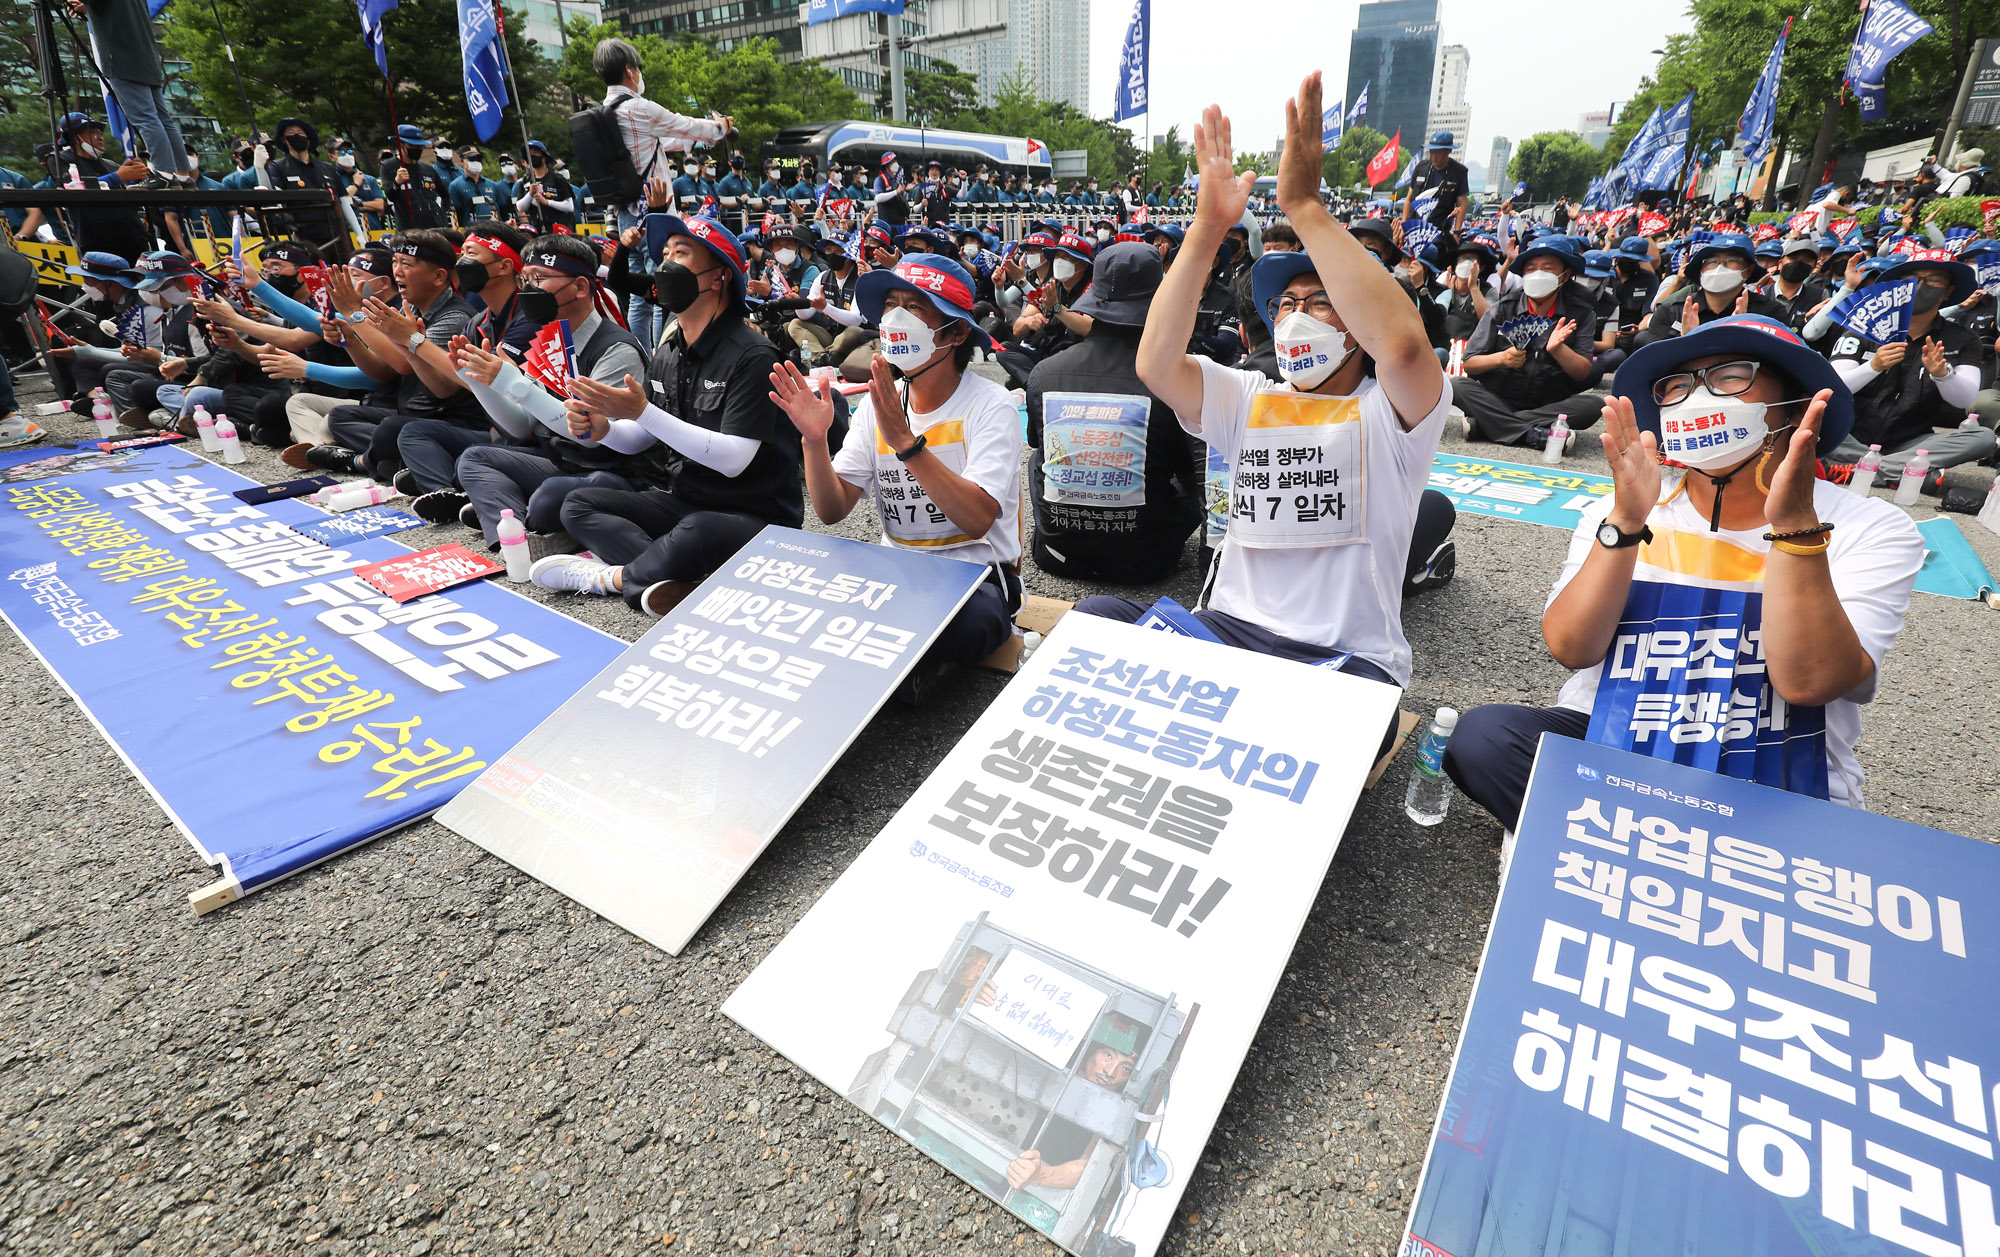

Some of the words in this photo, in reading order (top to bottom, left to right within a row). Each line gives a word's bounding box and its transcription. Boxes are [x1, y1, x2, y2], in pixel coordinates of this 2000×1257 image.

[1068, 430, 1123, 448] 노동중심
[1085, 405, 1124, 421] 총파업
[1666, 420, 1678, 433] 하청
[1682, 412, 1726, 433] 노동자
[1075, 450, 1134, 469] 산업전환!
[1276, 445, 1323, 466] 정부가
[1667, 438, 1681, 451] 임금
[1686, 431, 1729, 451] 올려라
[7, 482, 99, 519] 노동중심
[879, 486, 906, 501] 선하청
[1051, 468, 1098, 487] 노정교섭
[1101, 470, 1133, 487] 쟁취!
[1236, 471, 1270, 490] 선하청
[1277, 468, 1339, 490] 살려내라
[103, 475, 270, 534] 금속노조
[905, 504, 917, 523] 7
[1050, 505, 1138, 521] 전국금속노동조합
[1050, 514, 1138, 534] 기아자동차지부
[1266, 496, 1282, 521] 7
[1294, 491, 1346, 523] 일차
[38, 510, 150, 557] 산업전환
[185, 521, 373, 588] 총파업
[88, 544, 189, 583] 쟁취!
[734, 554, 898, 611] 하청노동자
[21, 574, 124, 648] 전국금속노동조합
[130, 574, 279, 649] 대우조선
[696, 585, 817, 644] 빼앗긴
[810, 615, 917, 669] 임금
[649, 622, 826, 702] 정상으로
[1609, 623, 1766, 682] 대우조선
[210, 630, 396, 733] 하청투쟁
[1049, 647, 1240, 724] 조선산업
[597, 662, 802, 759] 회복하라!
[318, 714, 487, 801] 승리!
[1022, 684, 1320, 805] 하청노동자의
[981, 728, 1233, 854] 생존권을
[1605, 773, 1735, 818] 전국금속노동조합
[927, 850, 1015, 899] 전국금속노동조합
[928, 780, 1232, 939] 보장하라!
[1566, 797, 1967, 959] 산업은행이
[1553, 851, 1878, 1004] 책임지고
[1023, 974, 1072, 1011] 이대로
[1532, 918, 2000, 1160] 대우조선
[1512, 1007, 2000, 1257] 해결하라
